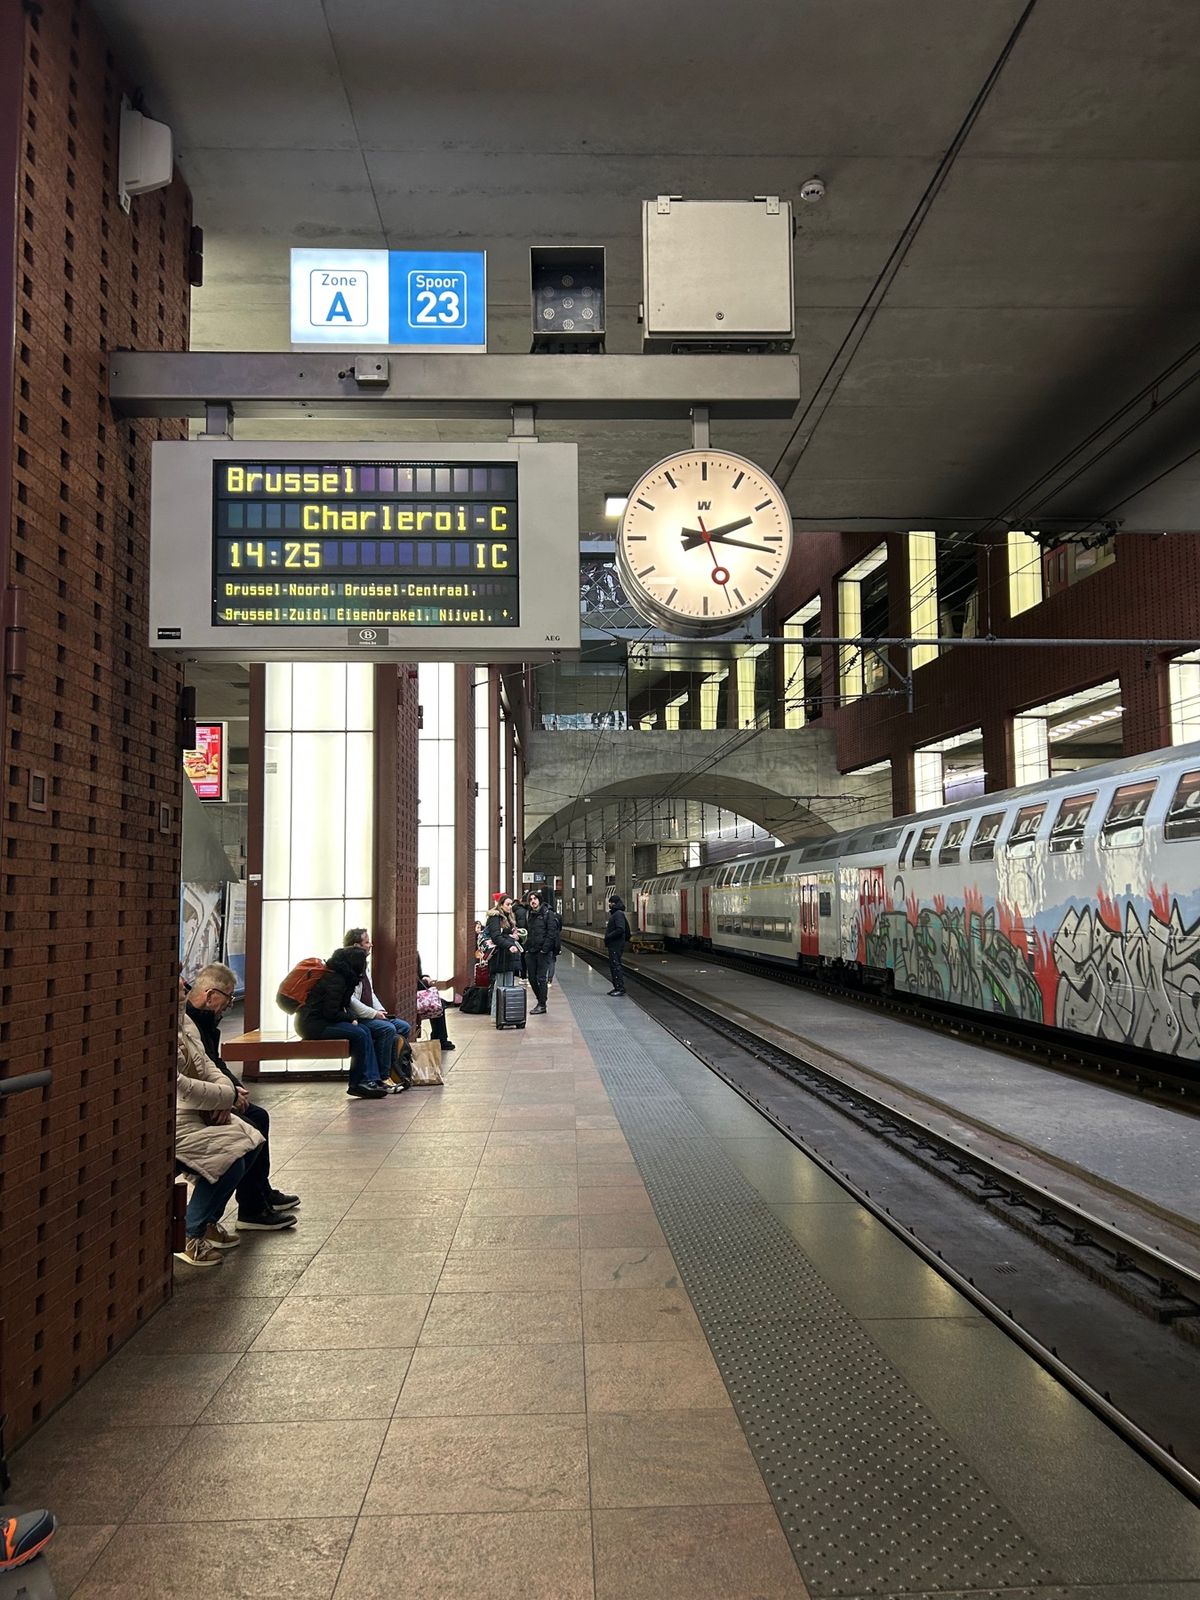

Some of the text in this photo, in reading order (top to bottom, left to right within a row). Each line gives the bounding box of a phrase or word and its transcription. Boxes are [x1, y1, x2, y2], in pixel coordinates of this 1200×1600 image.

[321, 273, 357, 286] Zone
[415, 275, 459, 291] Spoor
[325, 291, 352, 322] A
[416, 290, 459, 323] 23
[226, 466, 354, 494] Brussel
[302, 505, 507, 532] Charleroi-C
[697, 501, 711, 510] W
[229, 542, 507, 569] 14:25 IC
